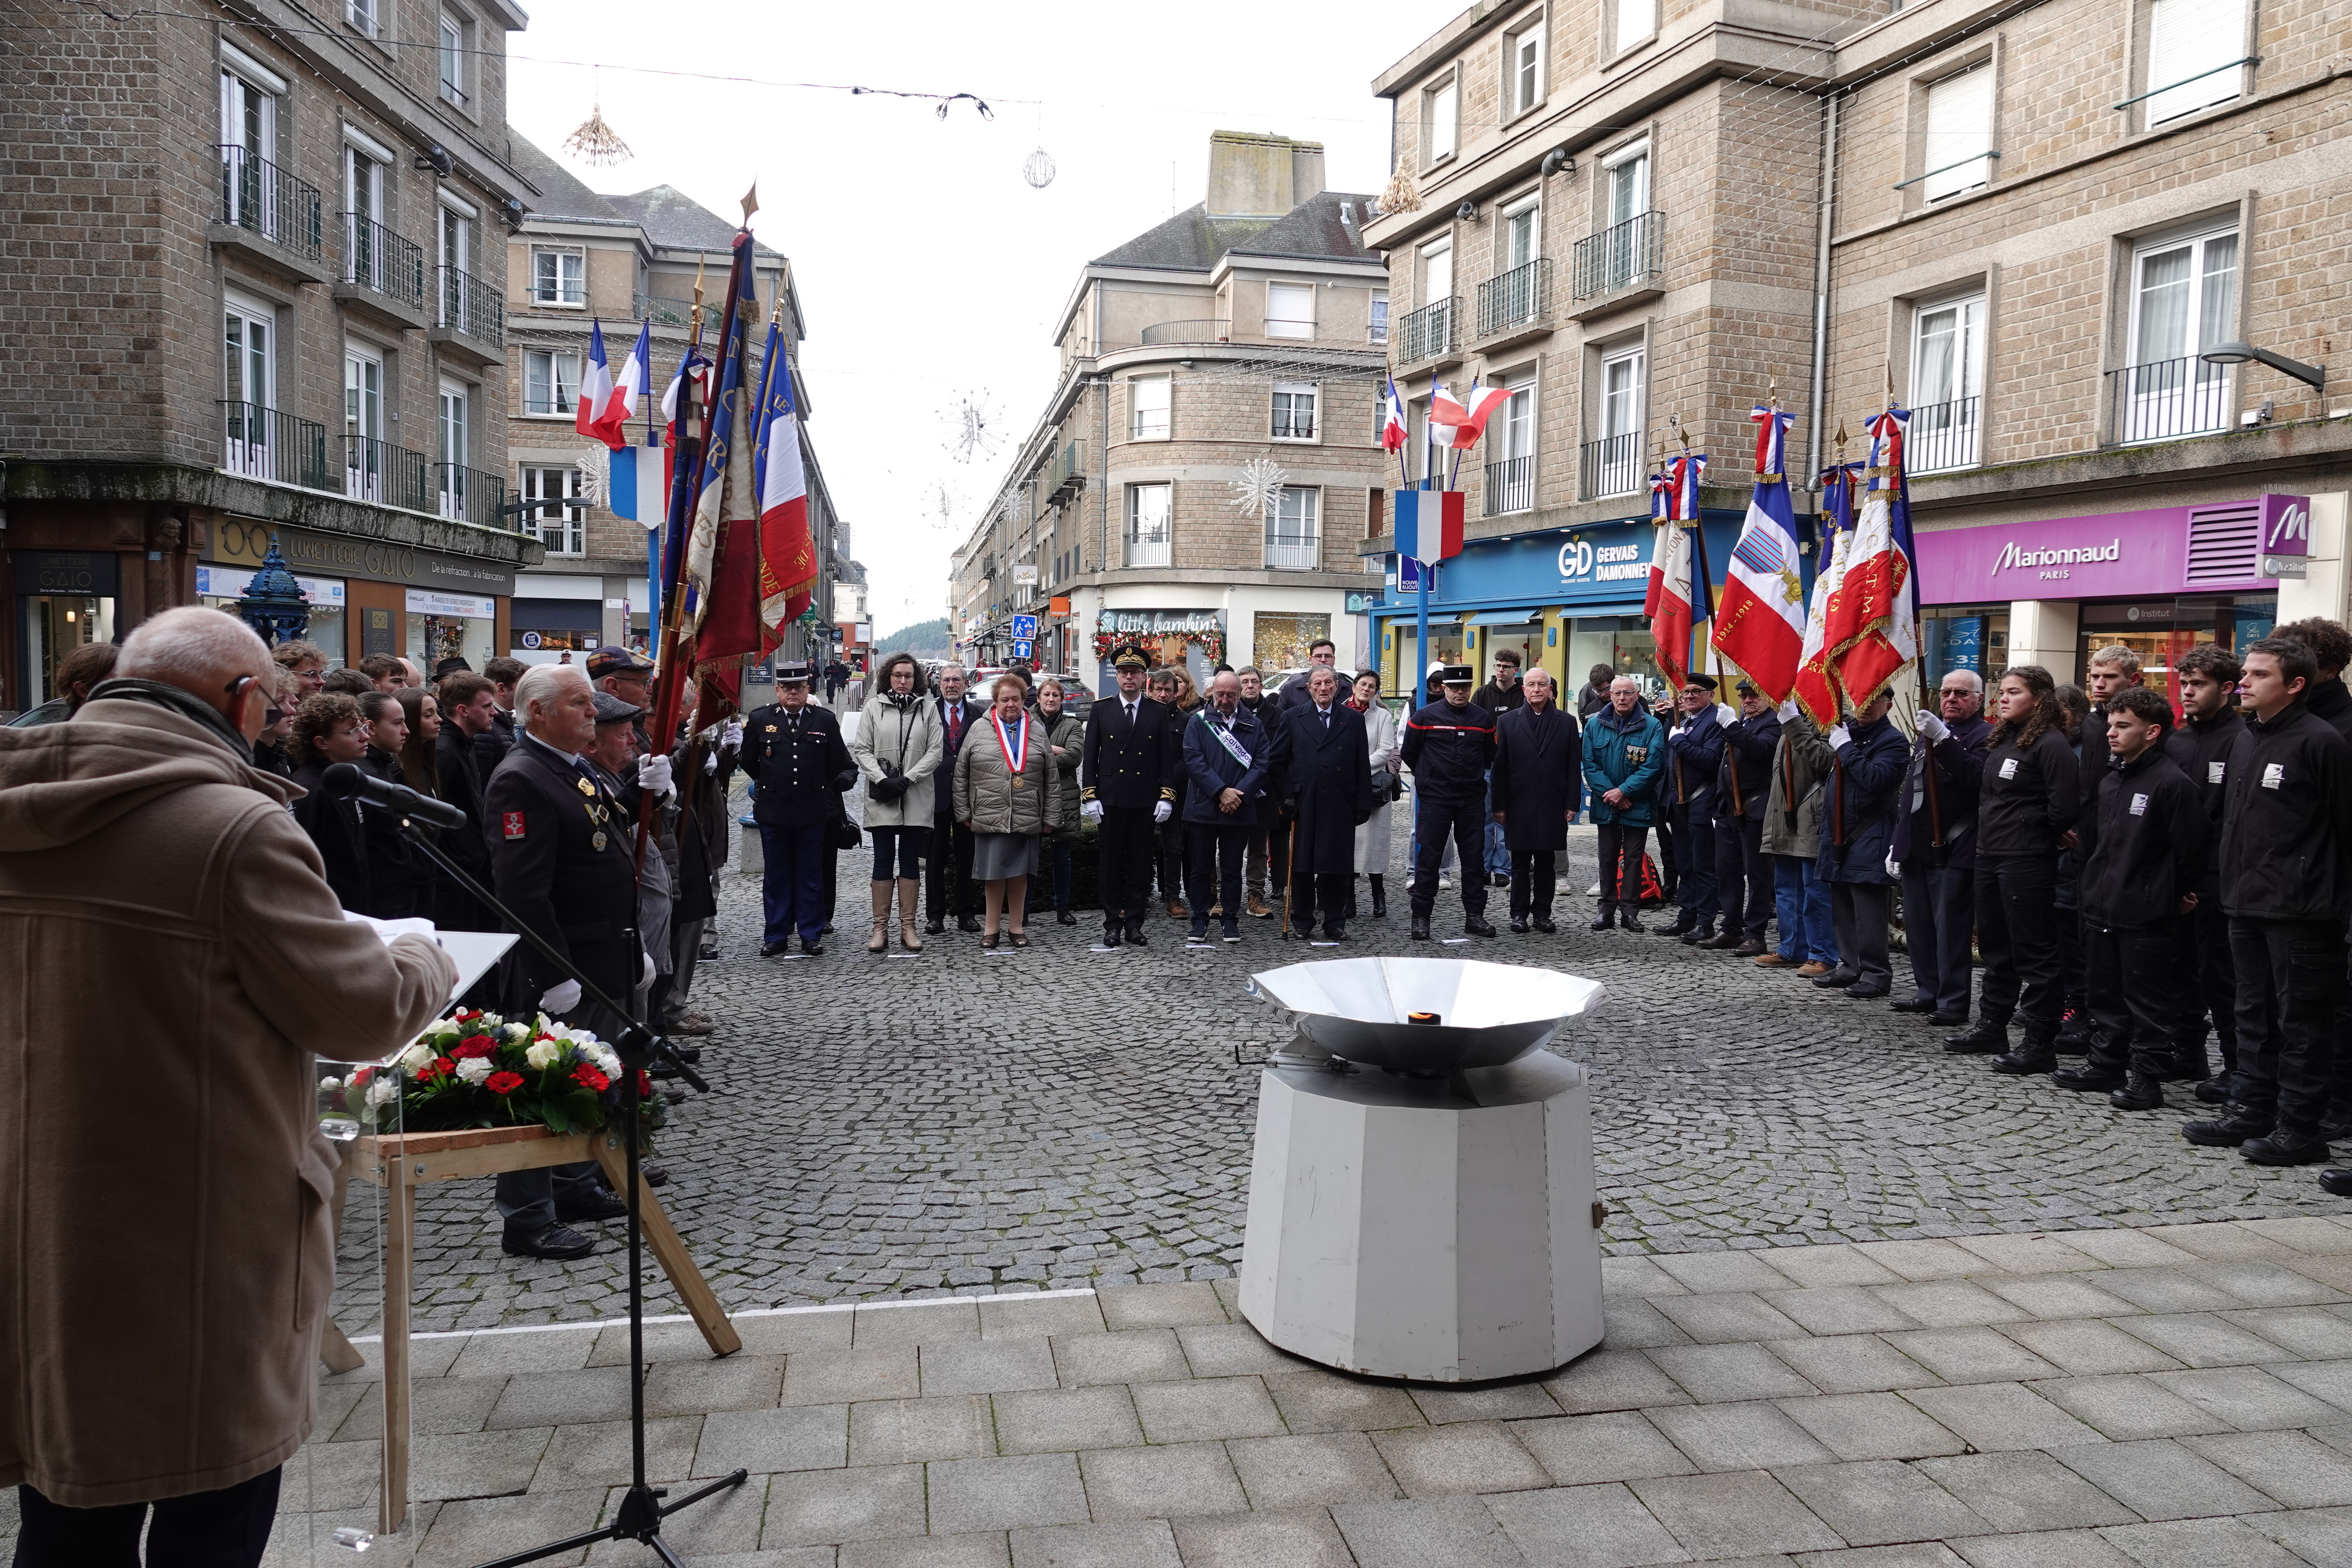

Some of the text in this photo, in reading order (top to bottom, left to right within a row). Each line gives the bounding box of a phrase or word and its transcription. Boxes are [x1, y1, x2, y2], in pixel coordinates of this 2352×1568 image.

[2269, 503, 2307, 548] M
[291, 539, 360, 565] LUNETTERIE
[1558, 541, 1593, 577] GD
[1596, 544, 1638, 564] GERVAIS
[1991, 538, 2120, 576] Marionnaud
[432, 562, 440, 573] De
[441, 564, 445, 573] la
[474, 568, 477, 578] à
[478, 569, 481, 579] la
[482, 570, 505, 582] fabrication
[2040, 570, 2070, 580] PARIS
[297, 581, 315, 591] VATION
[1735, 600, 1753, 619] 1918
[2141, 609, 2170, 617] Institut
[1118, 612, 1151, 633] little
[1717, 622, 1734, 642] 1914
[1225, 735, 1252, 763] Calvados
[1225, 743, 1250, 767] DÉPARTEMENT
